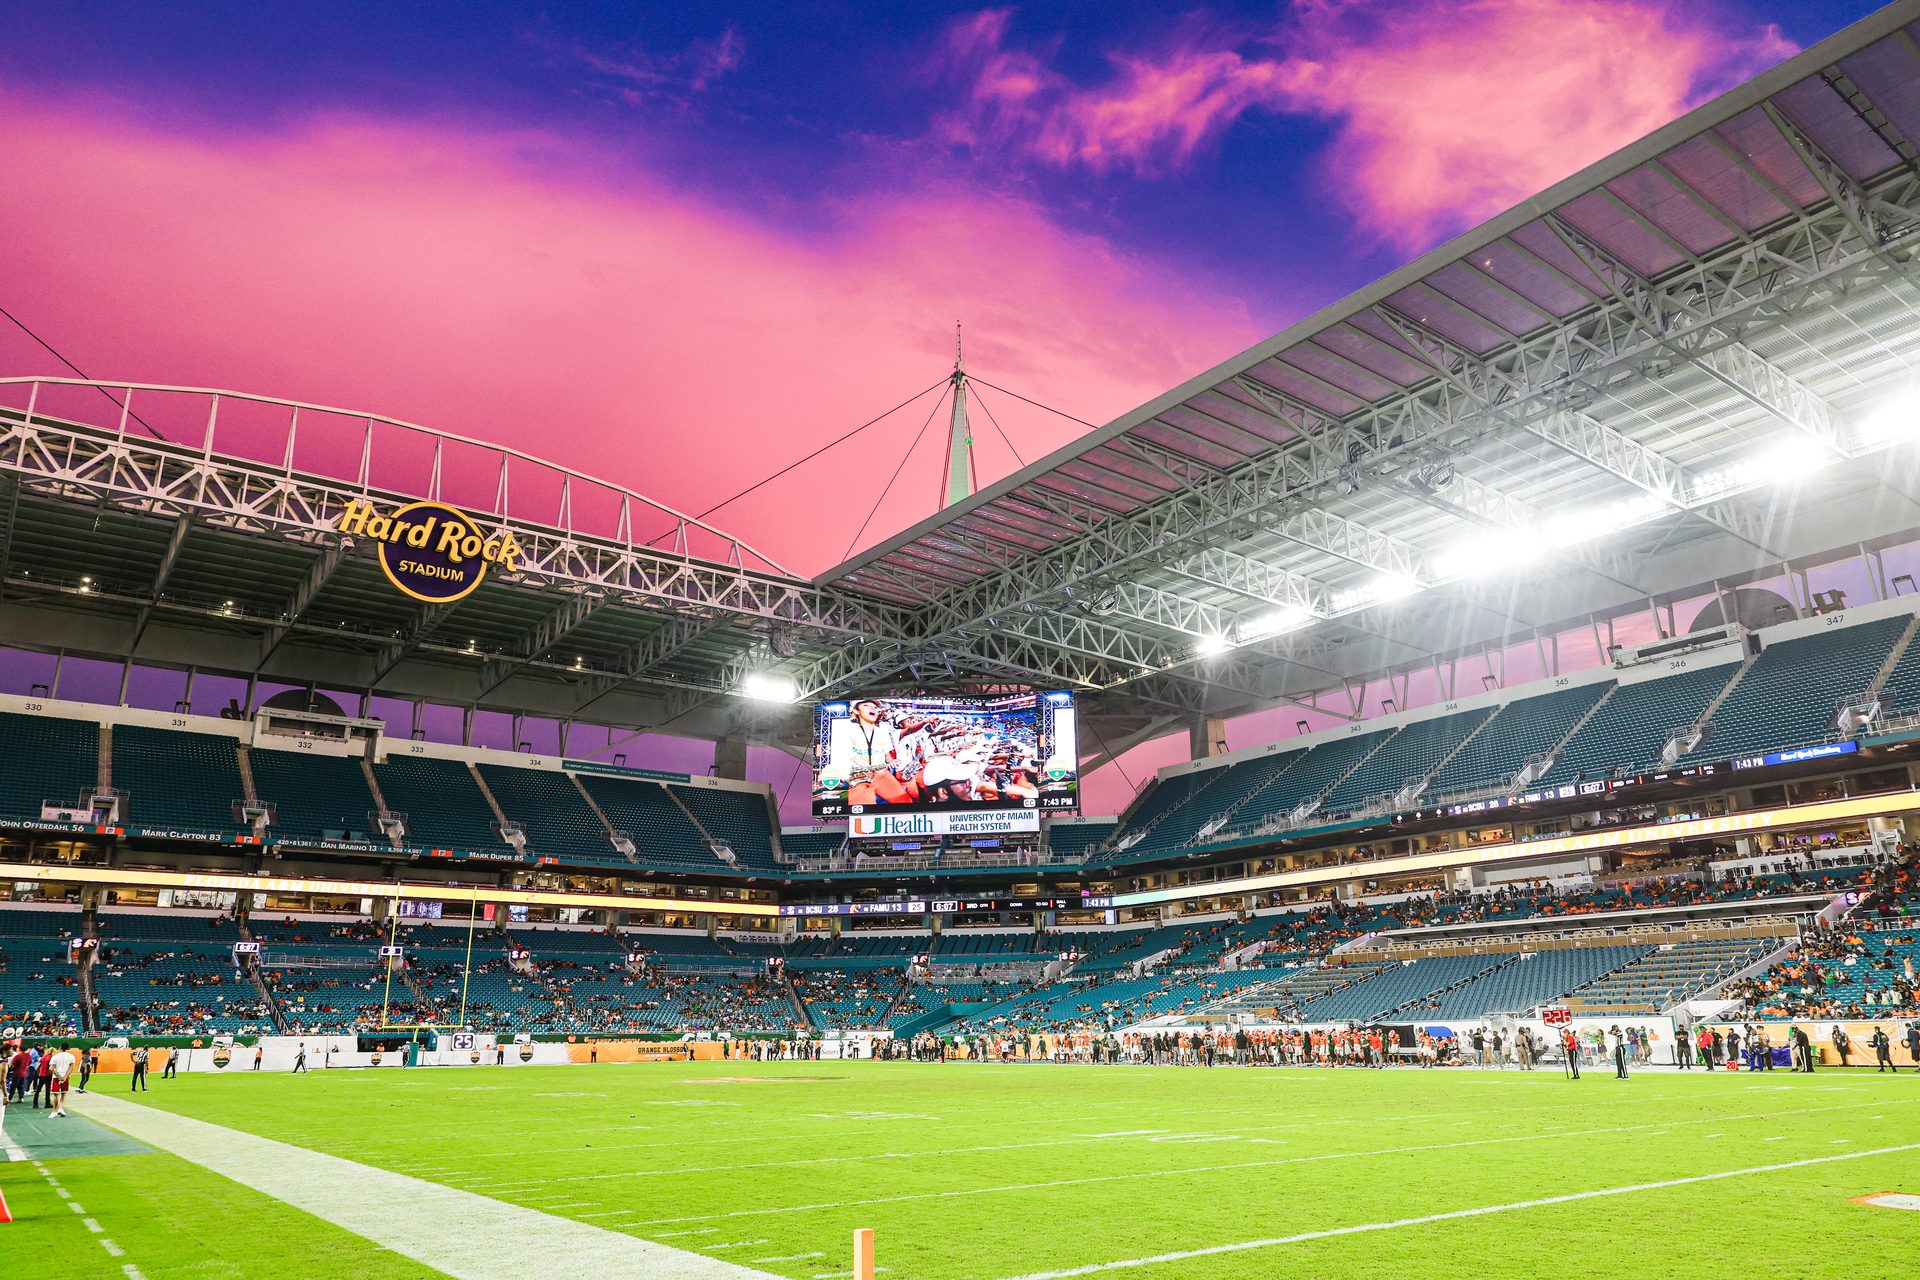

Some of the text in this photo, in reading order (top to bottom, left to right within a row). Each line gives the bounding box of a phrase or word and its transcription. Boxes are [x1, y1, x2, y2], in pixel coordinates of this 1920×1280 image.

[338, 499, 521, 572] Hard Rock
[398, 559, 464, 583] STADIUM
[1826, 614, 1845, 626] 347
[1670, 659, 1687, 670] 346
[1554, 677, 1569, 687] 345
[24, 703, 42, 712] 330
[1445, 703, 1458, 712] 344
[171, 719, 187, 728] 331
[1350, 725, 1362, 733] 343
[298, 741, 313, 749] 332
[410, 745, 424, 754] 333
[1266, 744, 1277, 752] 342
[529, 759, 542, 767] 334
[1752, 757, 1765, 767] PM
[1584, 784, 1601, 793] 6:07
[1543, 790, 1555, 799] 13
[1024, 799, 1035, 807] CC
[1042, 797, 1074, 807] 7:43 PM
[836, 806, 842, 814] F
[949, 811, 1034, 823] UNIVERSITY OF MIAMI
[1073, 816, 1086, 824] 340
[0, 819, 85, 832] OHN OFFERDAHL 56
[949, 821, 1012, 832] HEALTH SYSTEM
[141, 828, 221, 841] MARK CLAYTON 83
[1481, 840, 1565, 861] FLORIDA
[1627, 811, 1775, 844] UNIVERSITY
[320, 841, 337, 850] DAN
[338, 842, 368, 852] MARINO
[369, 844, 378, 852] 13
[468, 851, 489, 859] MARK
[490, 853, 512, 861] DUPER
[184, 873, 261, 890] FLORIDA
[310, 881, 408, 897] UNIVERSITY
[869, 903, 902, 912] FAMU 13
[912, 903, 922, 911] 25
[936, 903, 954, 911] 6:07
[1085, 898, 1110, 908] 7:43 PM
[805, 905, 823, 914] SCSU
[827, 904, 839, 913] 28
[455, 1035, 472, 1049] 25
[1726, 1062, 1736, 1070] 20
